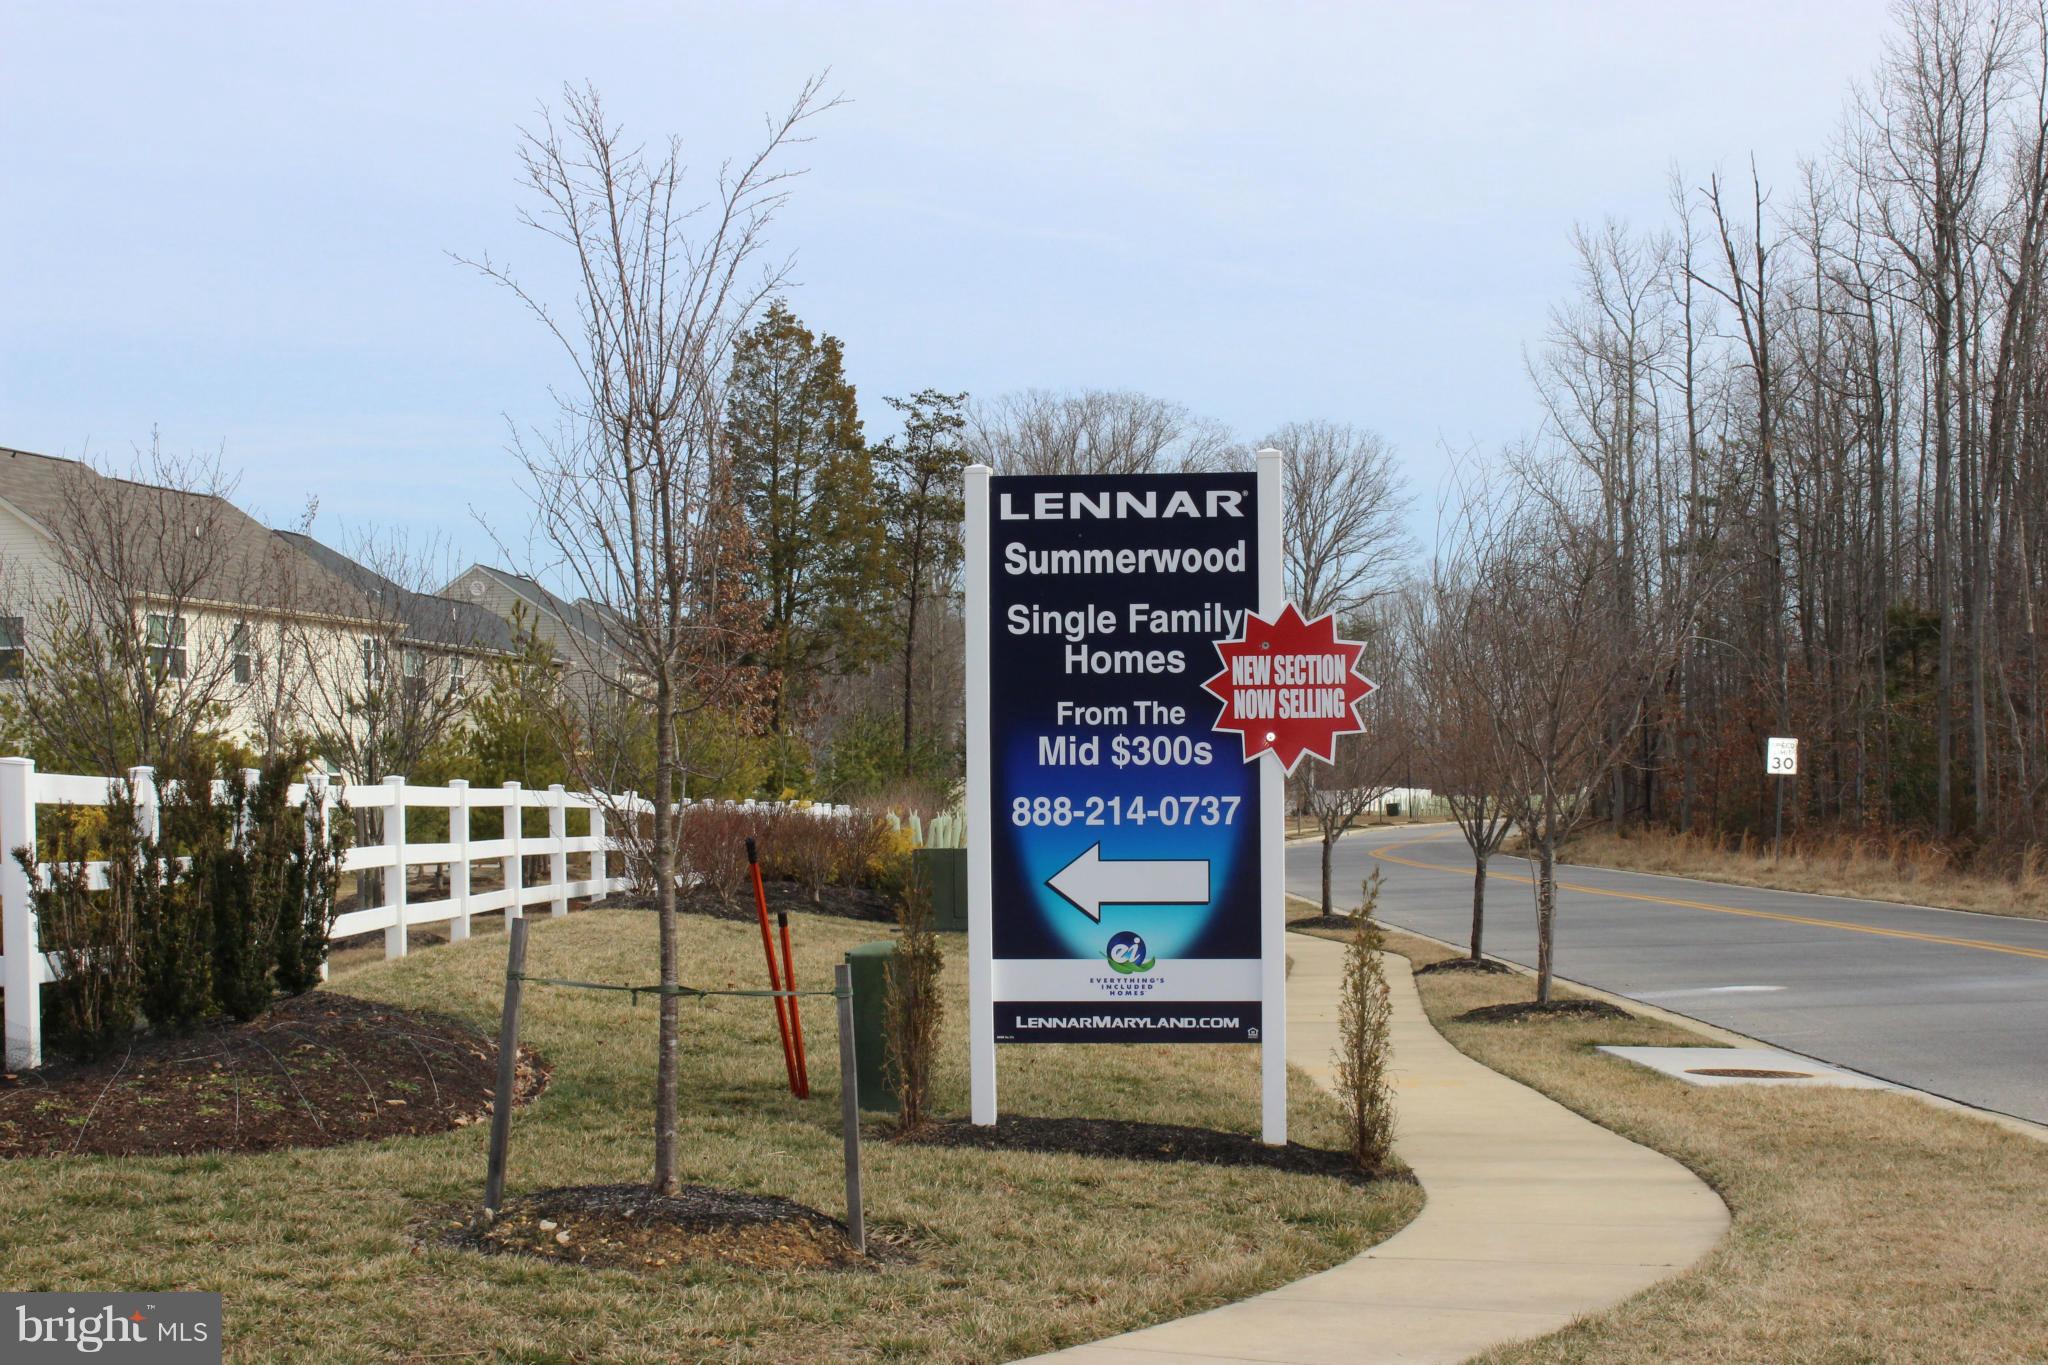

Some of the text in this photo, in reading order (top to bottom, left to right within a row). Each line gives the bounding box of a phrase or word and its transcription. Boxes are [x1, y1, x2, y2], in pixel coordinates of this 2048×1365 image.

[1004, 540, 1246, 575] Summerwood
[1007, 602, 1242, 642] Single Family
[1065, 645, 1186, 674] Homes
[1232, 654, 1346, 686] NEW SECTION
[1057, 701, 1186, 725] From The
[1234, 688, 1345, 719] NOW SELLING
[1038, 733, 1213, 770] Mid $300s
[1772, 757, 1794, 770] 30
[1011, 795, 1242, 827] 888-214-0737
